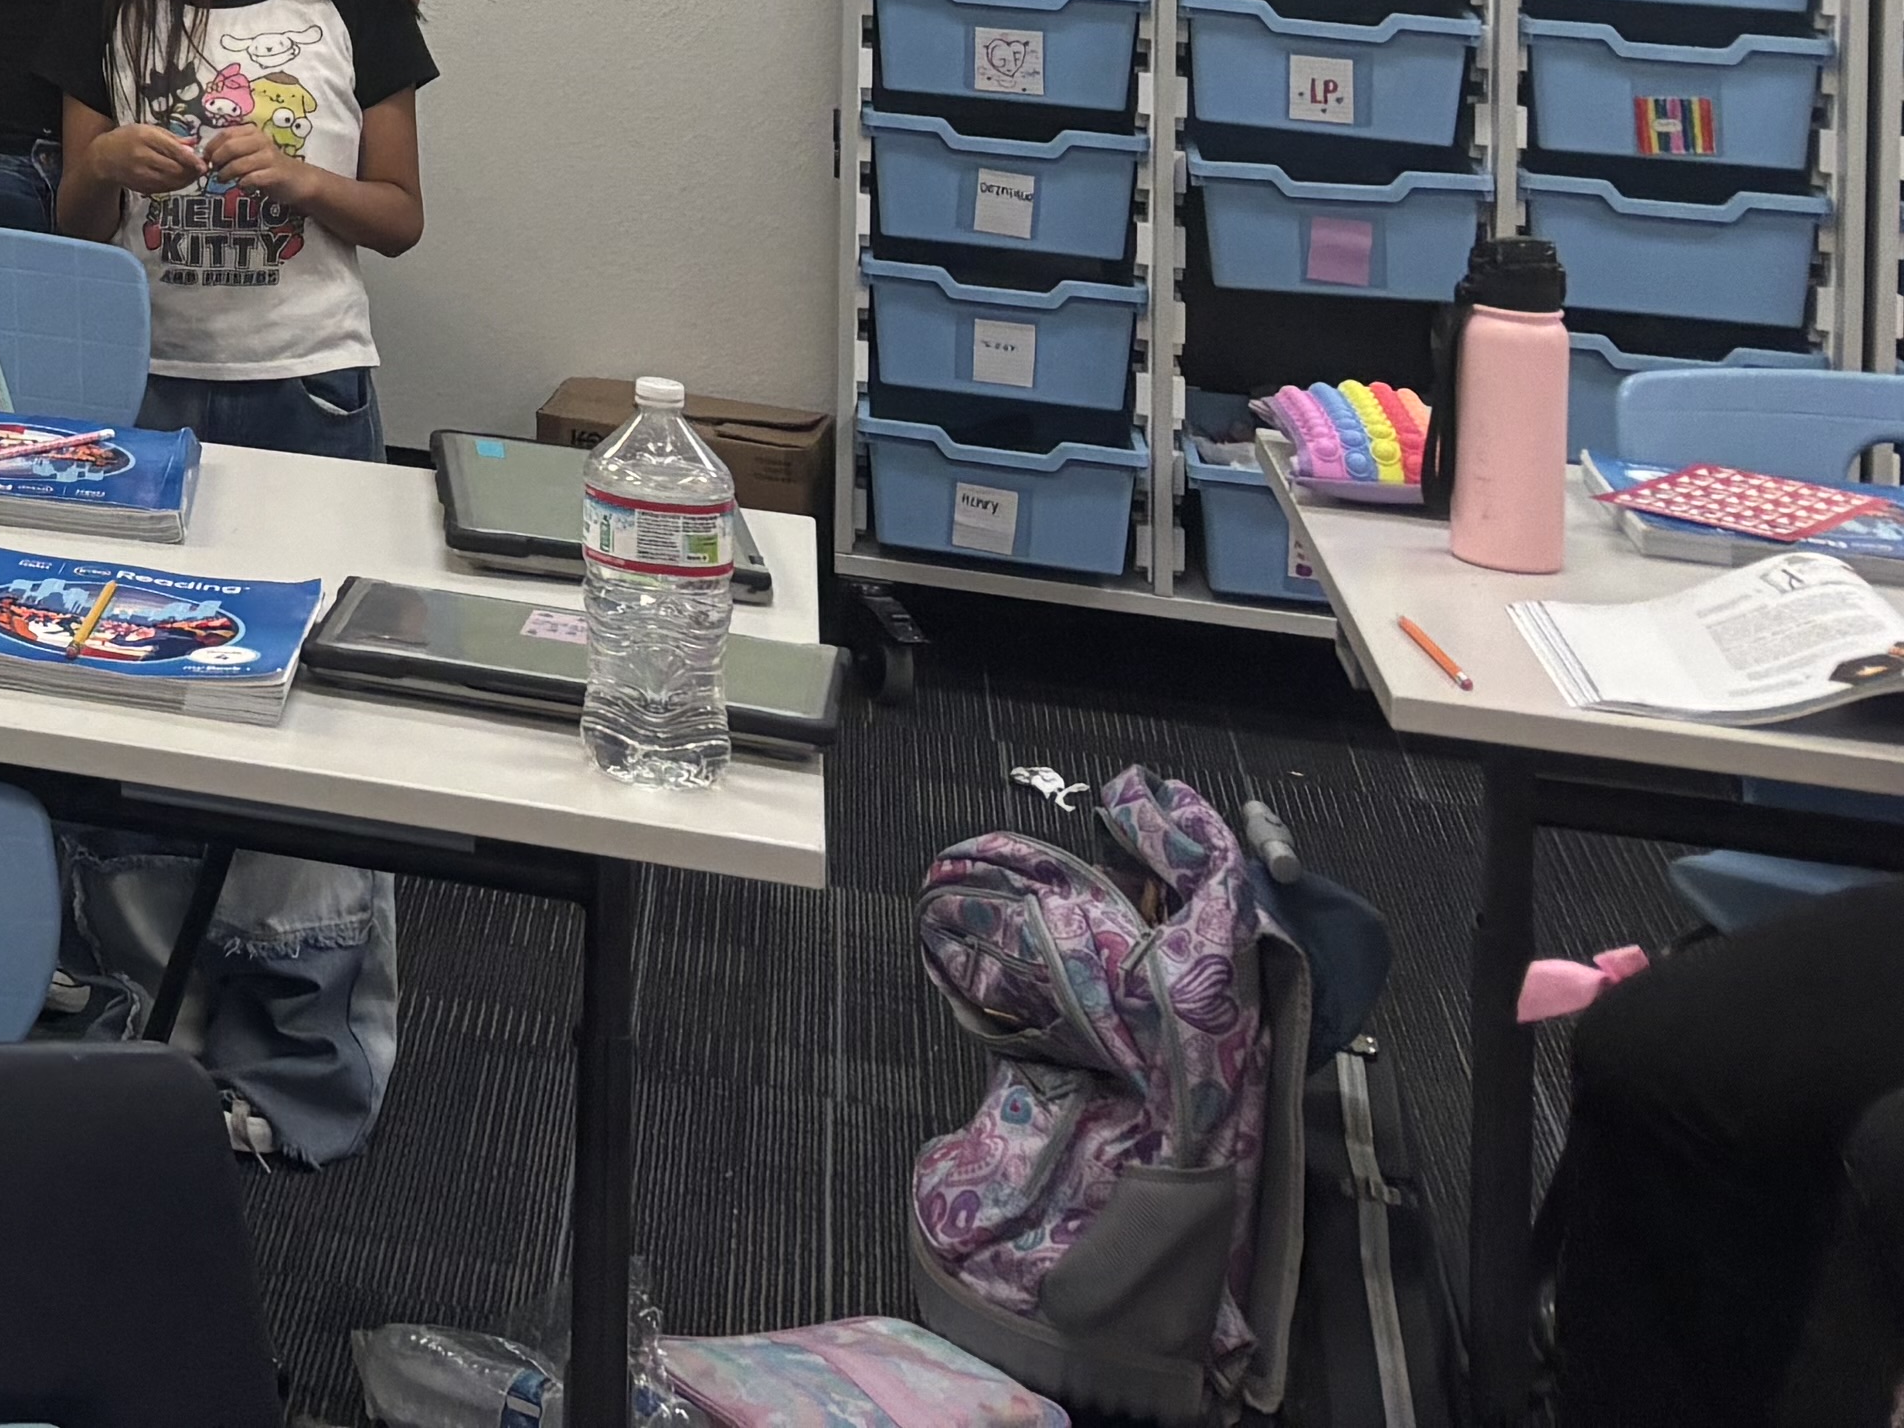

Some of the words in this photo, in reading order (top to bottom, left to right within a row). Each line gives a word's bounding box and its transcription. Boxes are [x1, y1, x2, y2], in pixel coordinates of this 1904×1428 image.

[1310, 77, 1338, 105] LP
[160, 195, 290, 231] HELLO
[161, 230, 292, 269] KITTY
[160, 269, 199, 286] AND
[116, 569, 246, 595] Reading
